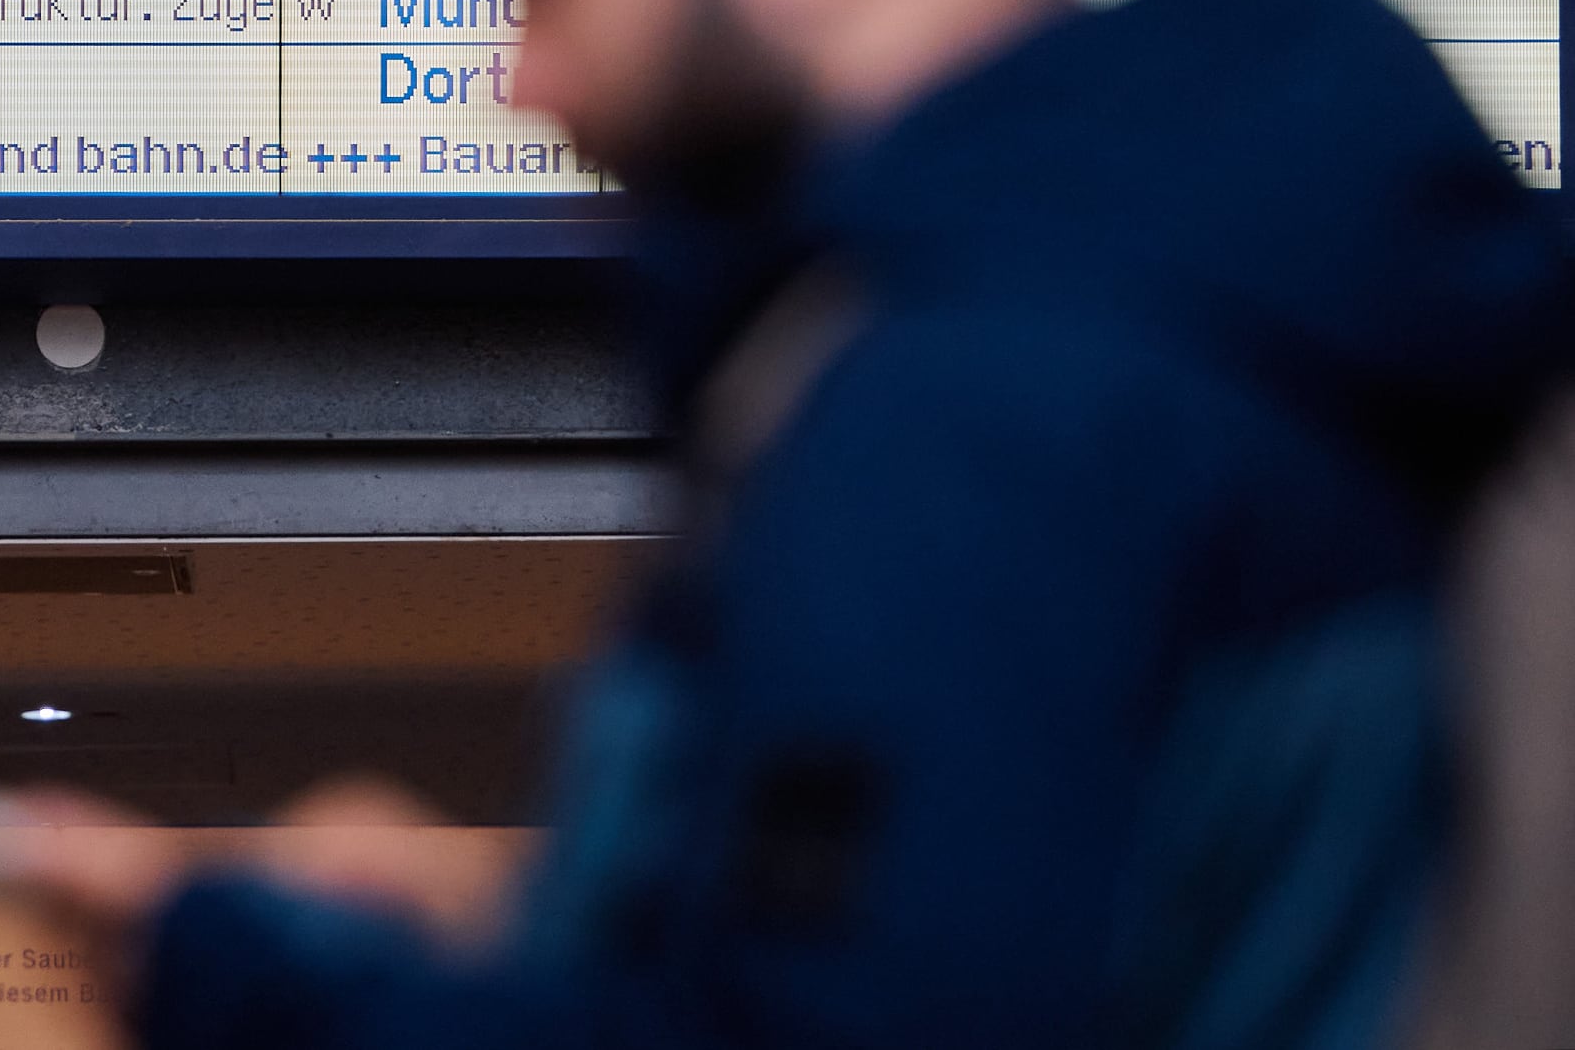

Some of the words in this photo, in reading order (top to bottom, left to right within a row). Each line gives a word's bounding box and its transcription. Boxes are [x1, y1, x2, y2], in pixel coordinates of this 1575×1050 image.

[380, 53, 507, 104] Dort
[77, 136, 288, 174] bahn.de
[420, 137, 598, 173] Bauar
[22, 948, 86, 969] Saub
